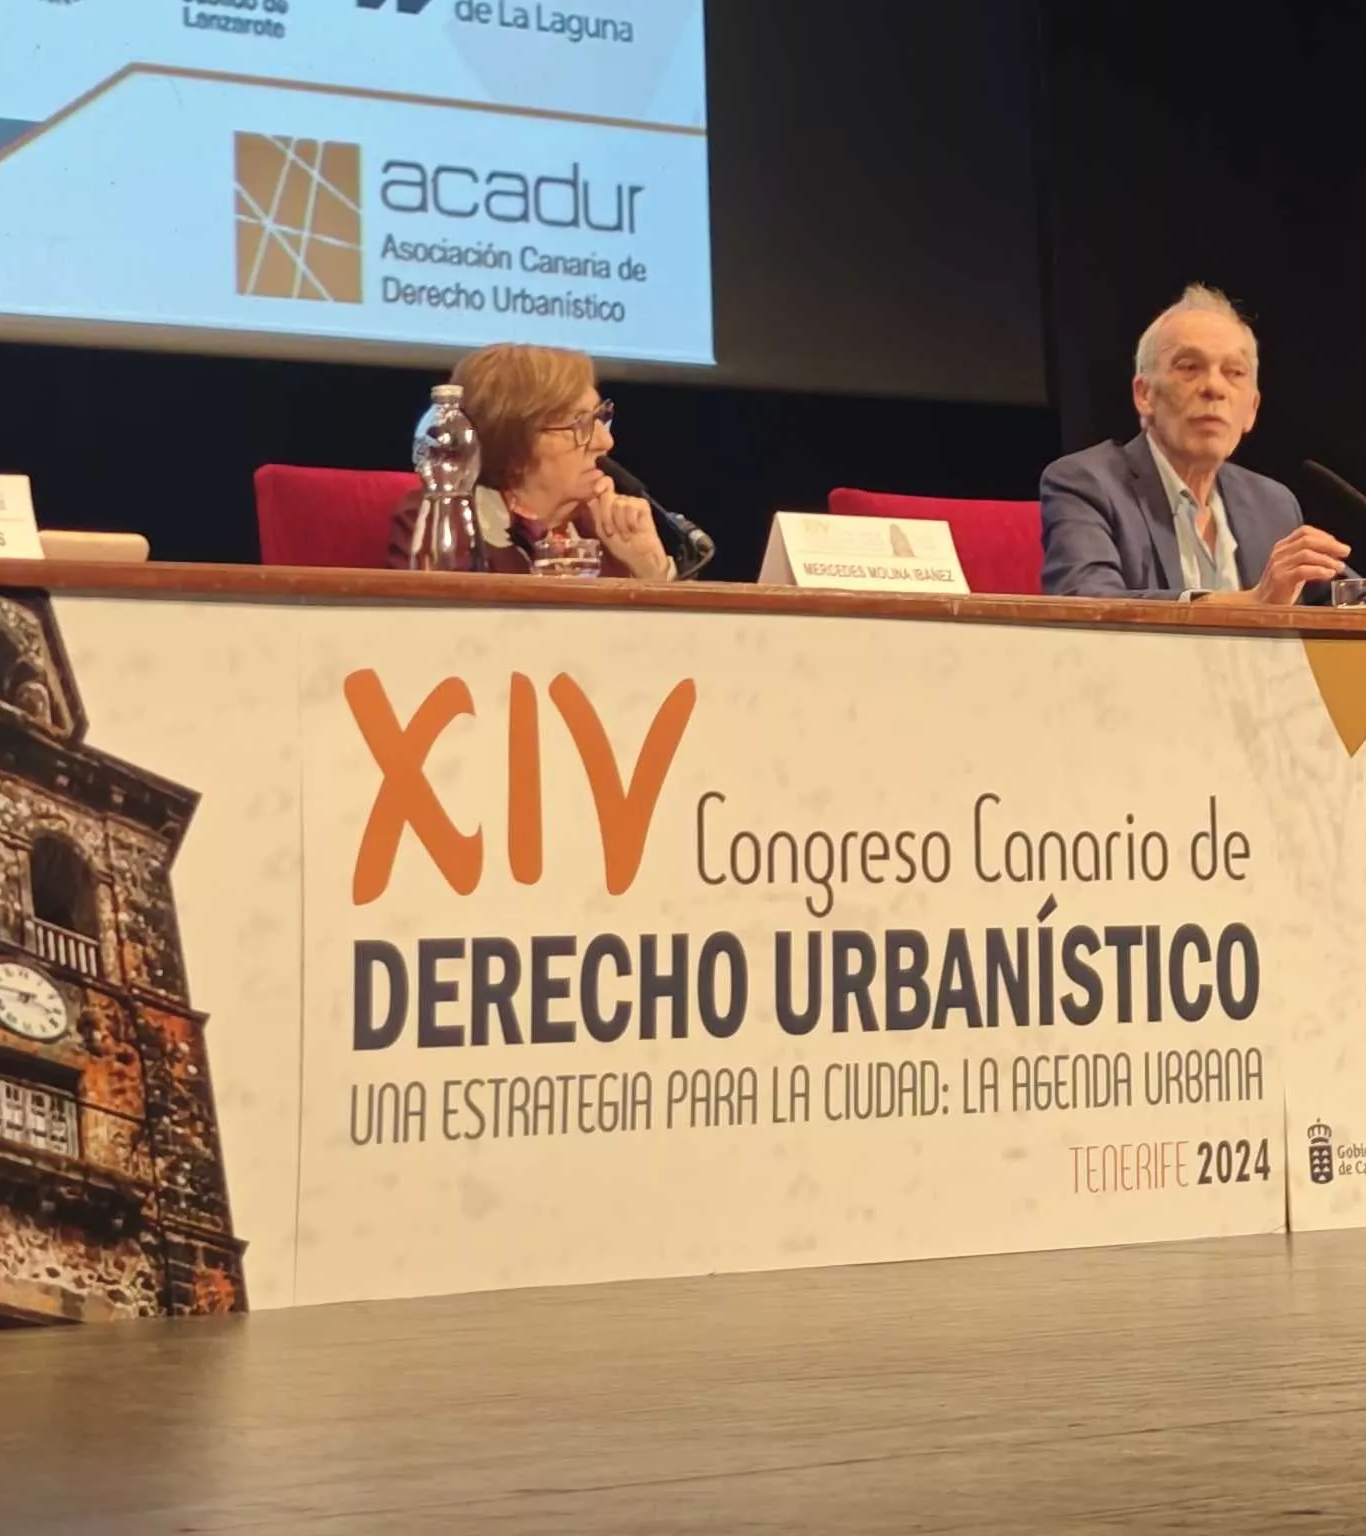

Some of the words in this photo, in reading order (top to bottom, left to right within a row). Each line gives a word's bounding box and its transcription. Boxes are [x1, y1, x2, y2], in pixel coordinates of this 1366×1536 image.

[182, 5, 287, 40] Lanzarote
[535, 4, 635, 44] Laguna
[381, 158, 646, 236] acadur
[381, 233, 514, 273] Asociación
[519, 246, 612, 281] Canaria
[617, 256, 649, 284] de
[381, 276, 486, 314] Derecho
[492, 286, 626, 324] Urbanístico
[803, 562, 867, 579] MERCEDES
[867, 566, 913, 582] MOLINA
[342, 667, 698, 906] XIV
[696, 791, 951, 918] Congreso
[974, 792, 1169, 883] Canario
[1190, 795, 1251, 882] de
[352, 930, 749, 1052] DERECHO
[774, 893, 1261, 1036] URBANÍSTICO
[349, 1080, 427, 1146] UNA
[441, 1070, 653, 1141] ESTRATEGIA
[666, 1067, 758, 1129] PARA
[771, 1064, 810, 1124] LA
[824, 1060, 951, 1122] CIUDAD:
[963, 1057, 1000, 1115] LA
[1011, 1052, 1133, 1113] AGENDA
[1143, 1047, 1264, 1106] URBANA
[1069, 1140, 1191, 1195] TENERIFE
[1196, 1138, 1272, 1186] 2024
[1338, 1161, 1353, 1176] de
